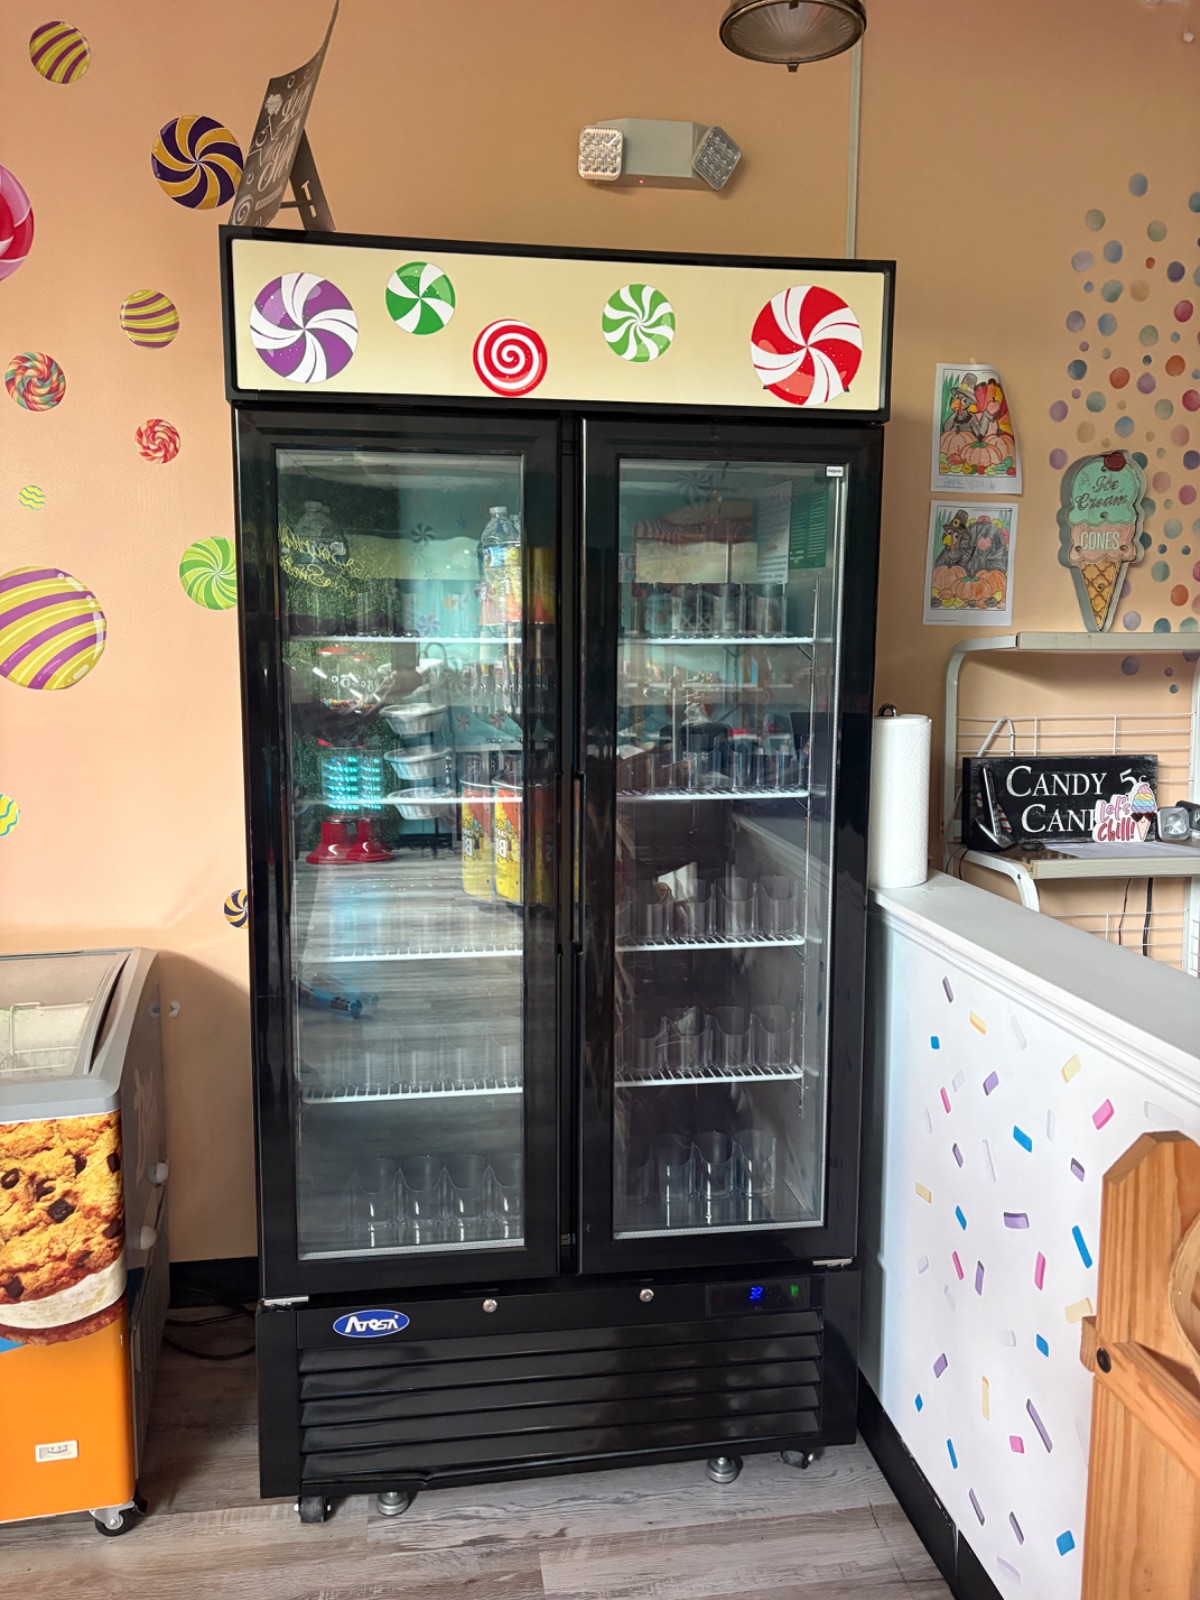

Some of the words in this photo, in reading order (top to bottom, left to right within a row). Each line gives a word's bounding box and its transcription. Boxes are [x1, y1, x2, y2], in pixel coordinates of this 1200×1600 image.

[1092, 476, 1119, 492] Ice
[1075, 492, 1128, 511] Cream
[1080, 531, 1120, 550] CONES
[1006, 765, 1107, 797] CANDY
[1099, 795, 1131, 823] Let's
[1097, 817, 1136, 842] Chill!
[344, 1315, 399, 1333] ATOSA
